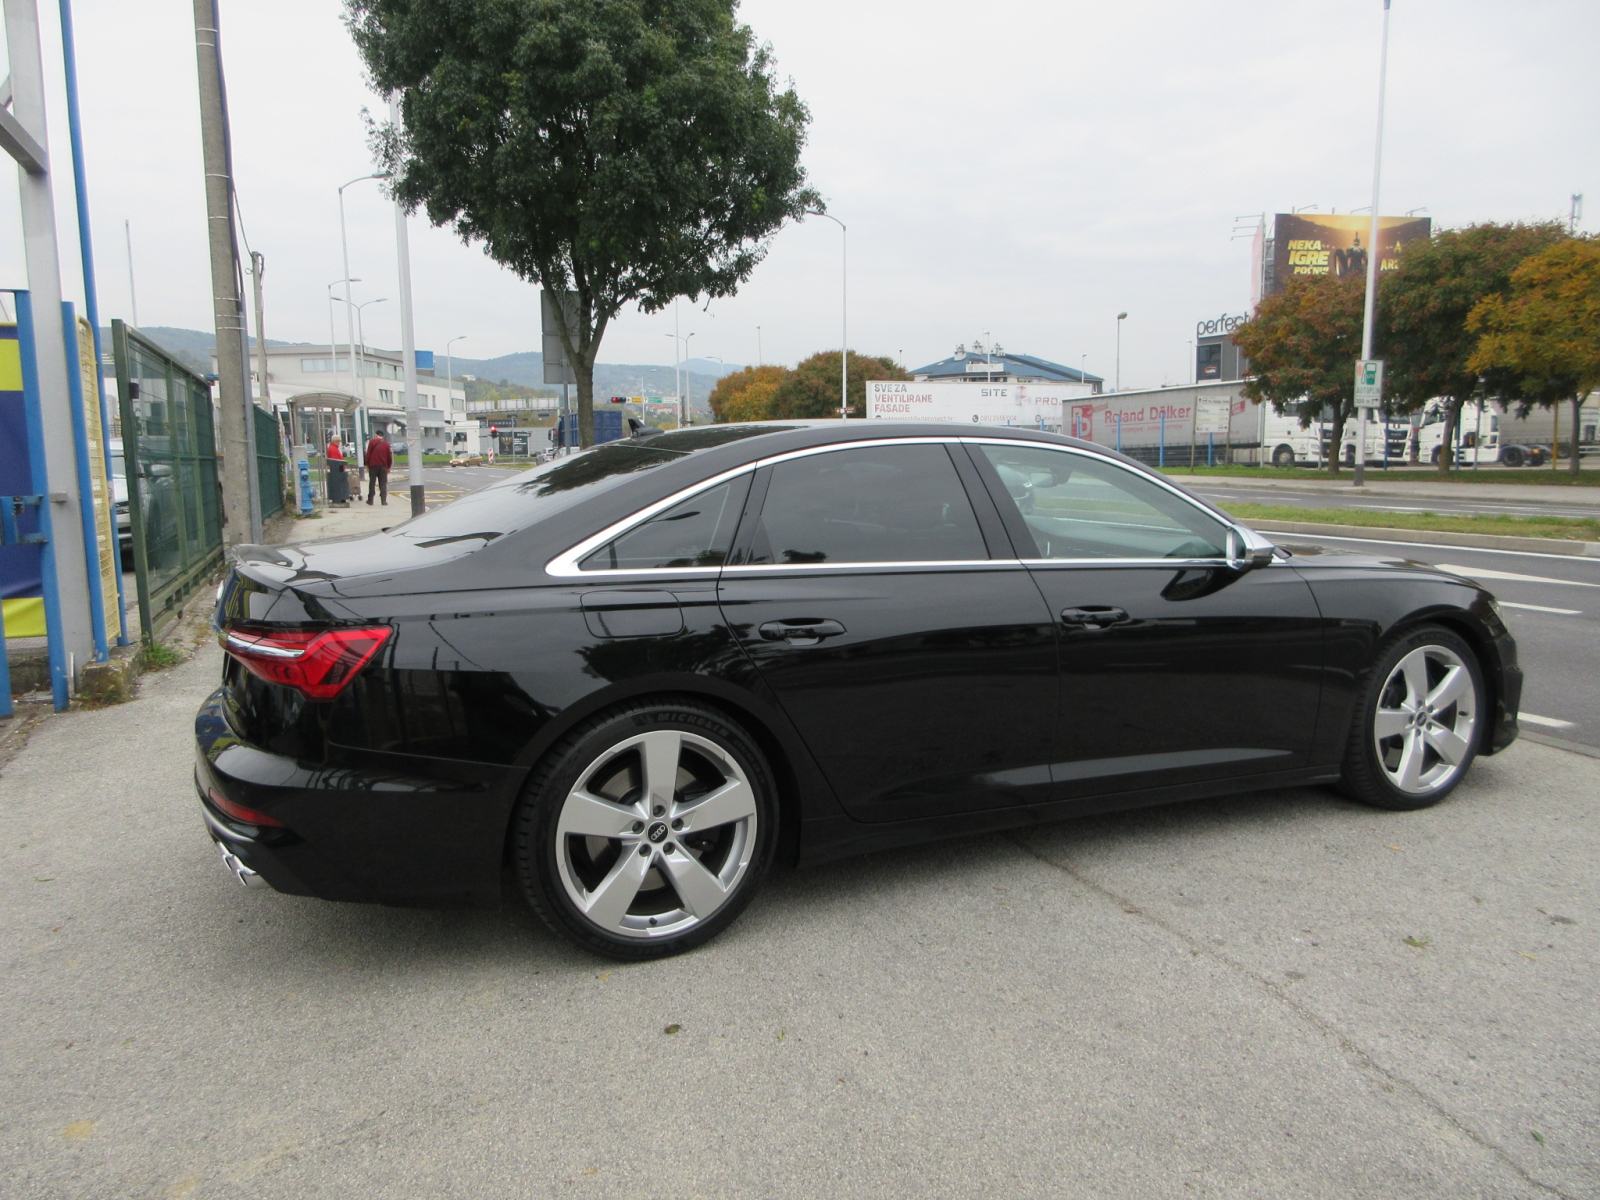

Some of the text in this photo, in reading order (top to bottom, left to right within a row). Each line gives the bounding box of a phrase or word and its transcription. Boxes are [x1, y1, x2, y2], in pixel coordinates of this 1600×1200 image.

[1288, 240, 1321, 250] NEKA
[1288, 251, 1330, 265] IGRE
[874, 384, 907, 392] SVE ZA
[875, 394, 933, 403] VENTILIRANE
[1035, 397, 1062, 405] PRO
[875, 404, 910, 412] FASADE
[1104, 409, 1144, 424] Roland
